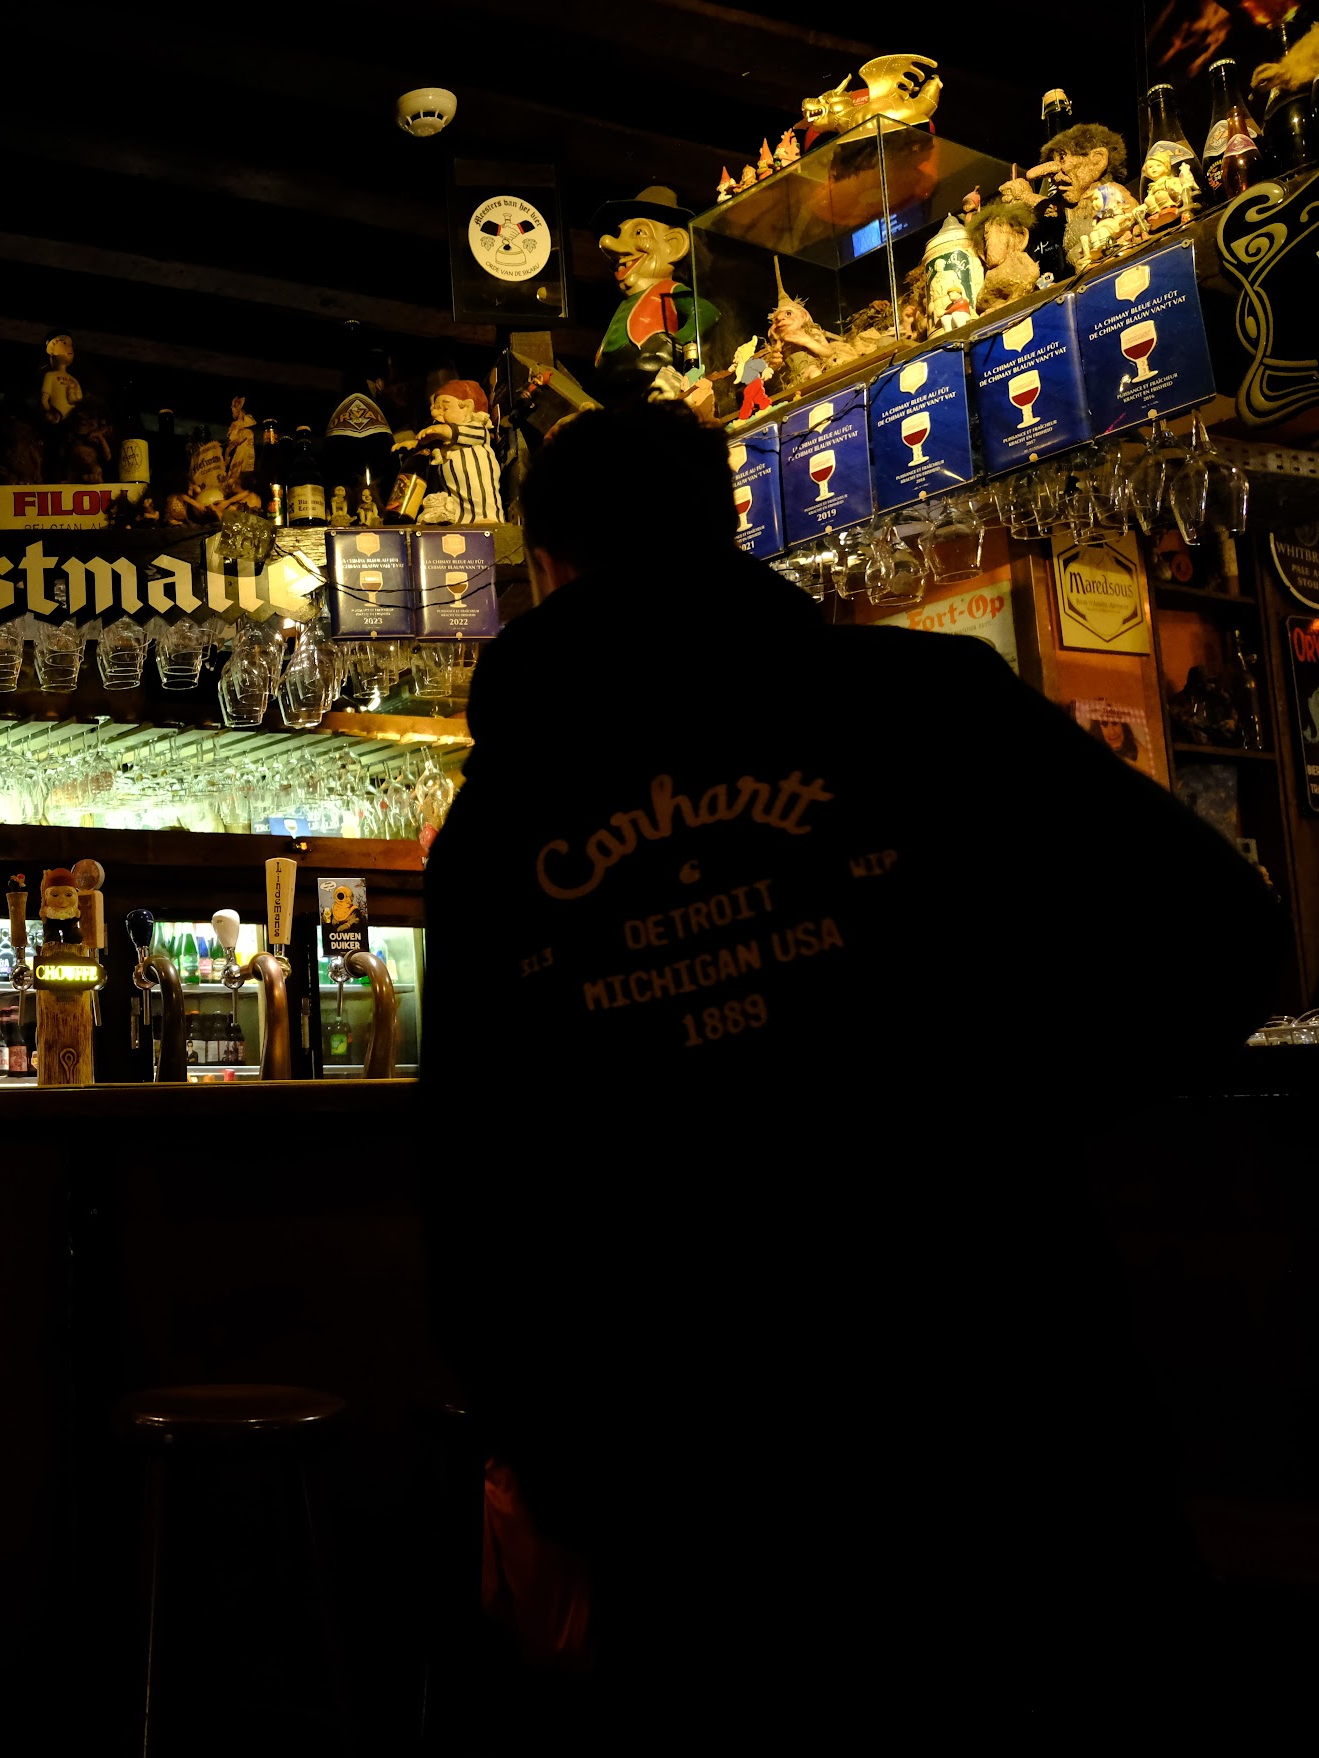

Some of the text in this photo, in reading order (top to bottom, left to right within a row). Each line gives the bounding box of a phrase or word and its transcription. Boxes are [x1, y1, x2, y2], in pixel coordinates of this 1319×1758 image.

[474, 199, 543, 228] Meesters van het bier
[485, 261, 500, 273] ORDE
[500, 268, 514, 277] VAN
[1088, 294, 1187, 341] DE CHIMAY BLAUW VAT
[1094, 289, 1179, 331] LA CHIMAY BLEUE AU FÛT
[979, 346, 1067, 388] DE CHIMAY BLAUW VAT
[984, 341, 1060, 378] LA CHIMAY BLEUE AU FÛT
[877, 391, 957, 428] DE CHIMAY BLAUW VAT
[882, 410, 889, 418] LA
[889, 401, 911, 414] CHIMAY
[911, 394, 928, 405] BLEUE
[927, 390, 937, 399] AU
[799, 437, 818, 451] CHIMAY
[818, 432, 834, 444] BLEUE
[833, 429, 842, 437] AU
[814, 440, 833, 453] BLAUW
[848, 431, 859, 439] VAT
[816, 508, 837, 522] 2019
[740, 541, 755, 552] 021
[1276, 541, 1319, 563] WHITBR
[1292, 563, 1309, 576] PALE
[1069, 571, 1134, 598] Maredsous
[363, 617, 383, 625] 2023
[449, 618, 469, 626] 2022
[907, 594, 1005, 632] Fort-Op
[536, 770, 836, 901] Carhartt
[848, 849, 899, 880] WIP
[274, 860, 283, 939] Lindemans
[623, 877, 776, 952] DETROIT
[328, 932, 362, 942] OUWEN
[329, 941, 361, 951] DUIKER
[35, 963, 99, 982] CHOUFFE
[582, 915, 845, 1012] MICHIGAN USA
[681, 992, 770, 1048] 1889
